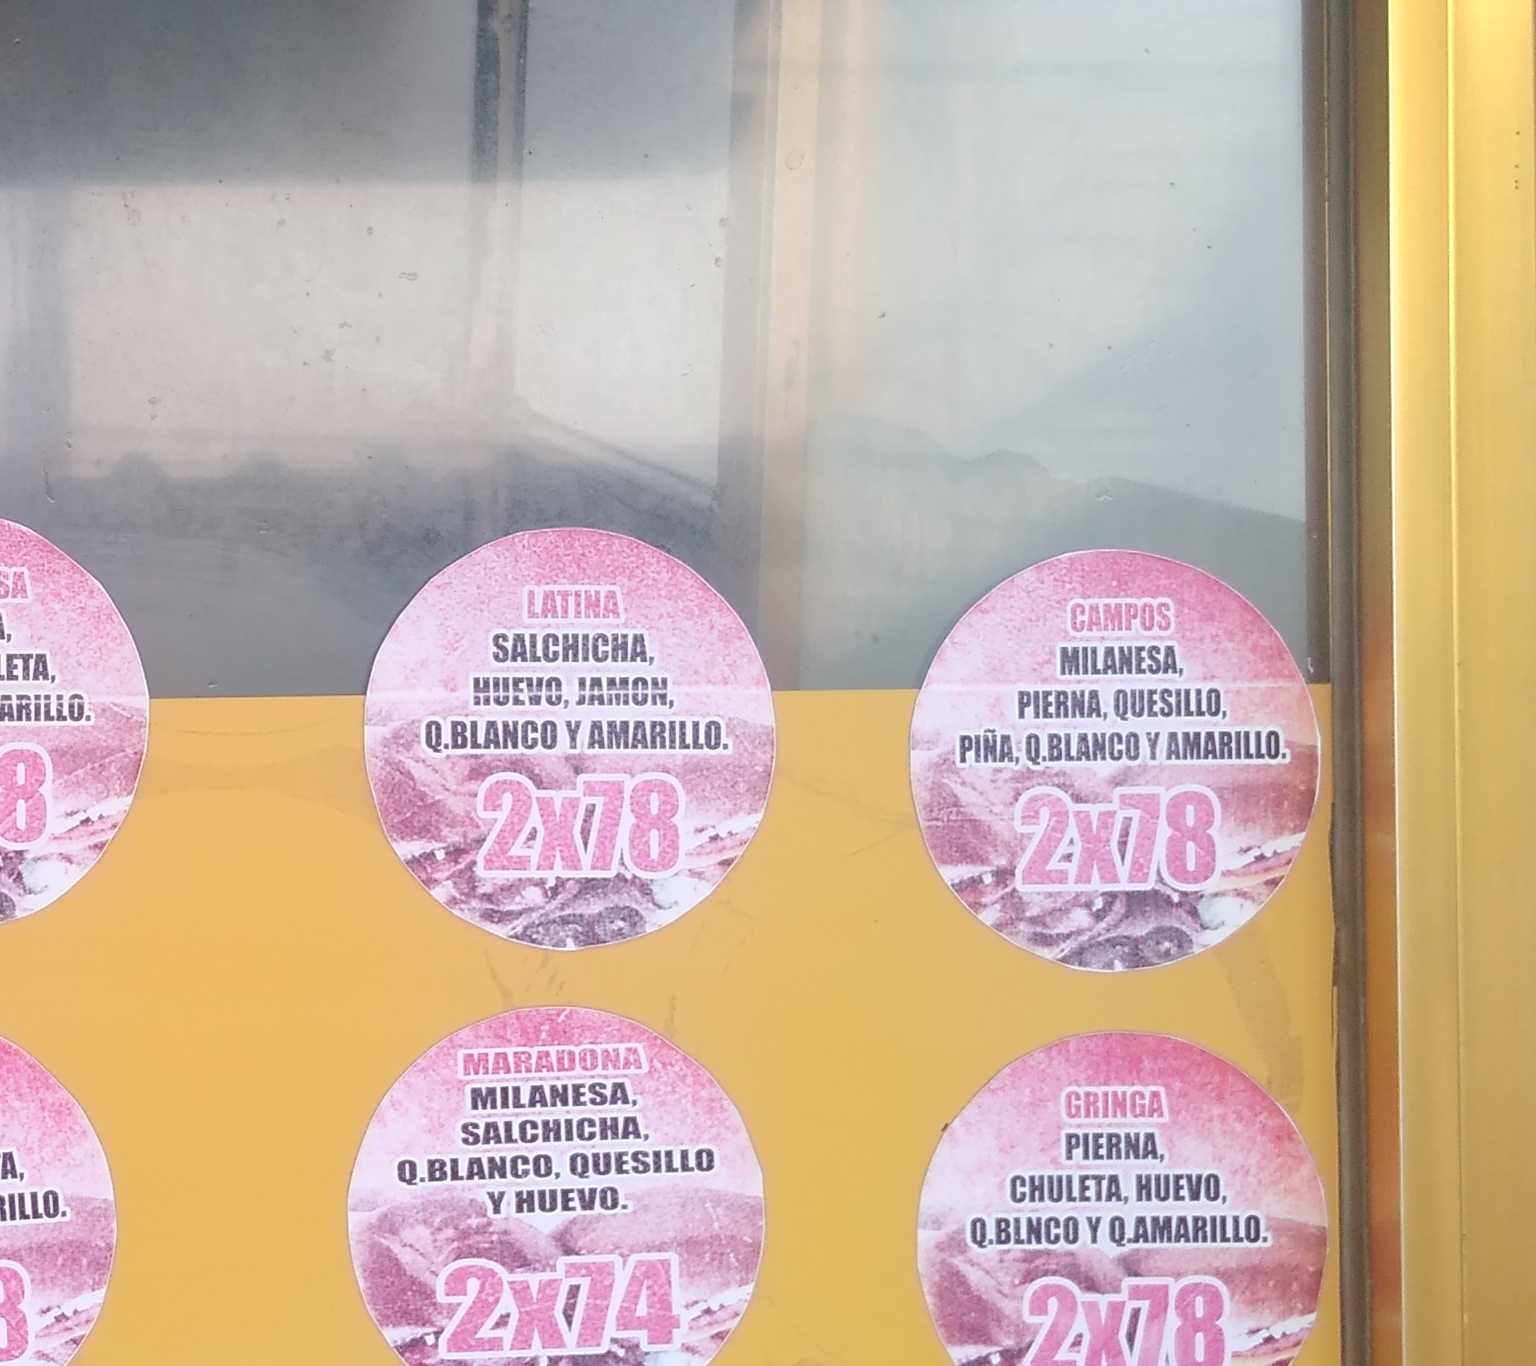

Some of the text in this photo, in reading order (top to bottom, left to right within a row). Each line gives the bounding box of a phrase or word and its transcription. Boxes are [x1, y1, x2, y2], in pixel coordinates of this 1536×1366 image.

[526, 589, 621, 620] LATINA
[1069, 601, 1173, 633] CAMPOS
[491, 632, 656, 666] SALCHICHA,
[1058, 644, 1185, 677] MILANESA,
[471, 676, 676, 710] HUEVO, JAMON,
[1016, 687, 1228, 722] PIERNA, QUESILLO,
[563, 720, 582, 751] Y
[586, 719, 730, 751] AMARILLO.
[958, 727, 1020, 767] PIÑA,
[1145, 730, 1162, 761] Y
[1165, 729, 1288, 762] AMARILLO.
[461, 1046, 644, 1077] MARADONA
[469, 1081, 639, 1112] MILANESA,
[1064, 1089, 1166, 1120] GRINGA
[460, 1115, 650, 1147] SALCHICHA,
[568, 1147, 716, 1179] QUESILLO
[1063, 1131, 1166, 1164] PIERNA,
[485, 1185, 629, 1216] Y HUEVO.
[1008, 1172, 1228, 1206] CHULETA, HUEVO,
[1085, 1214, 1104, 1245] Y
